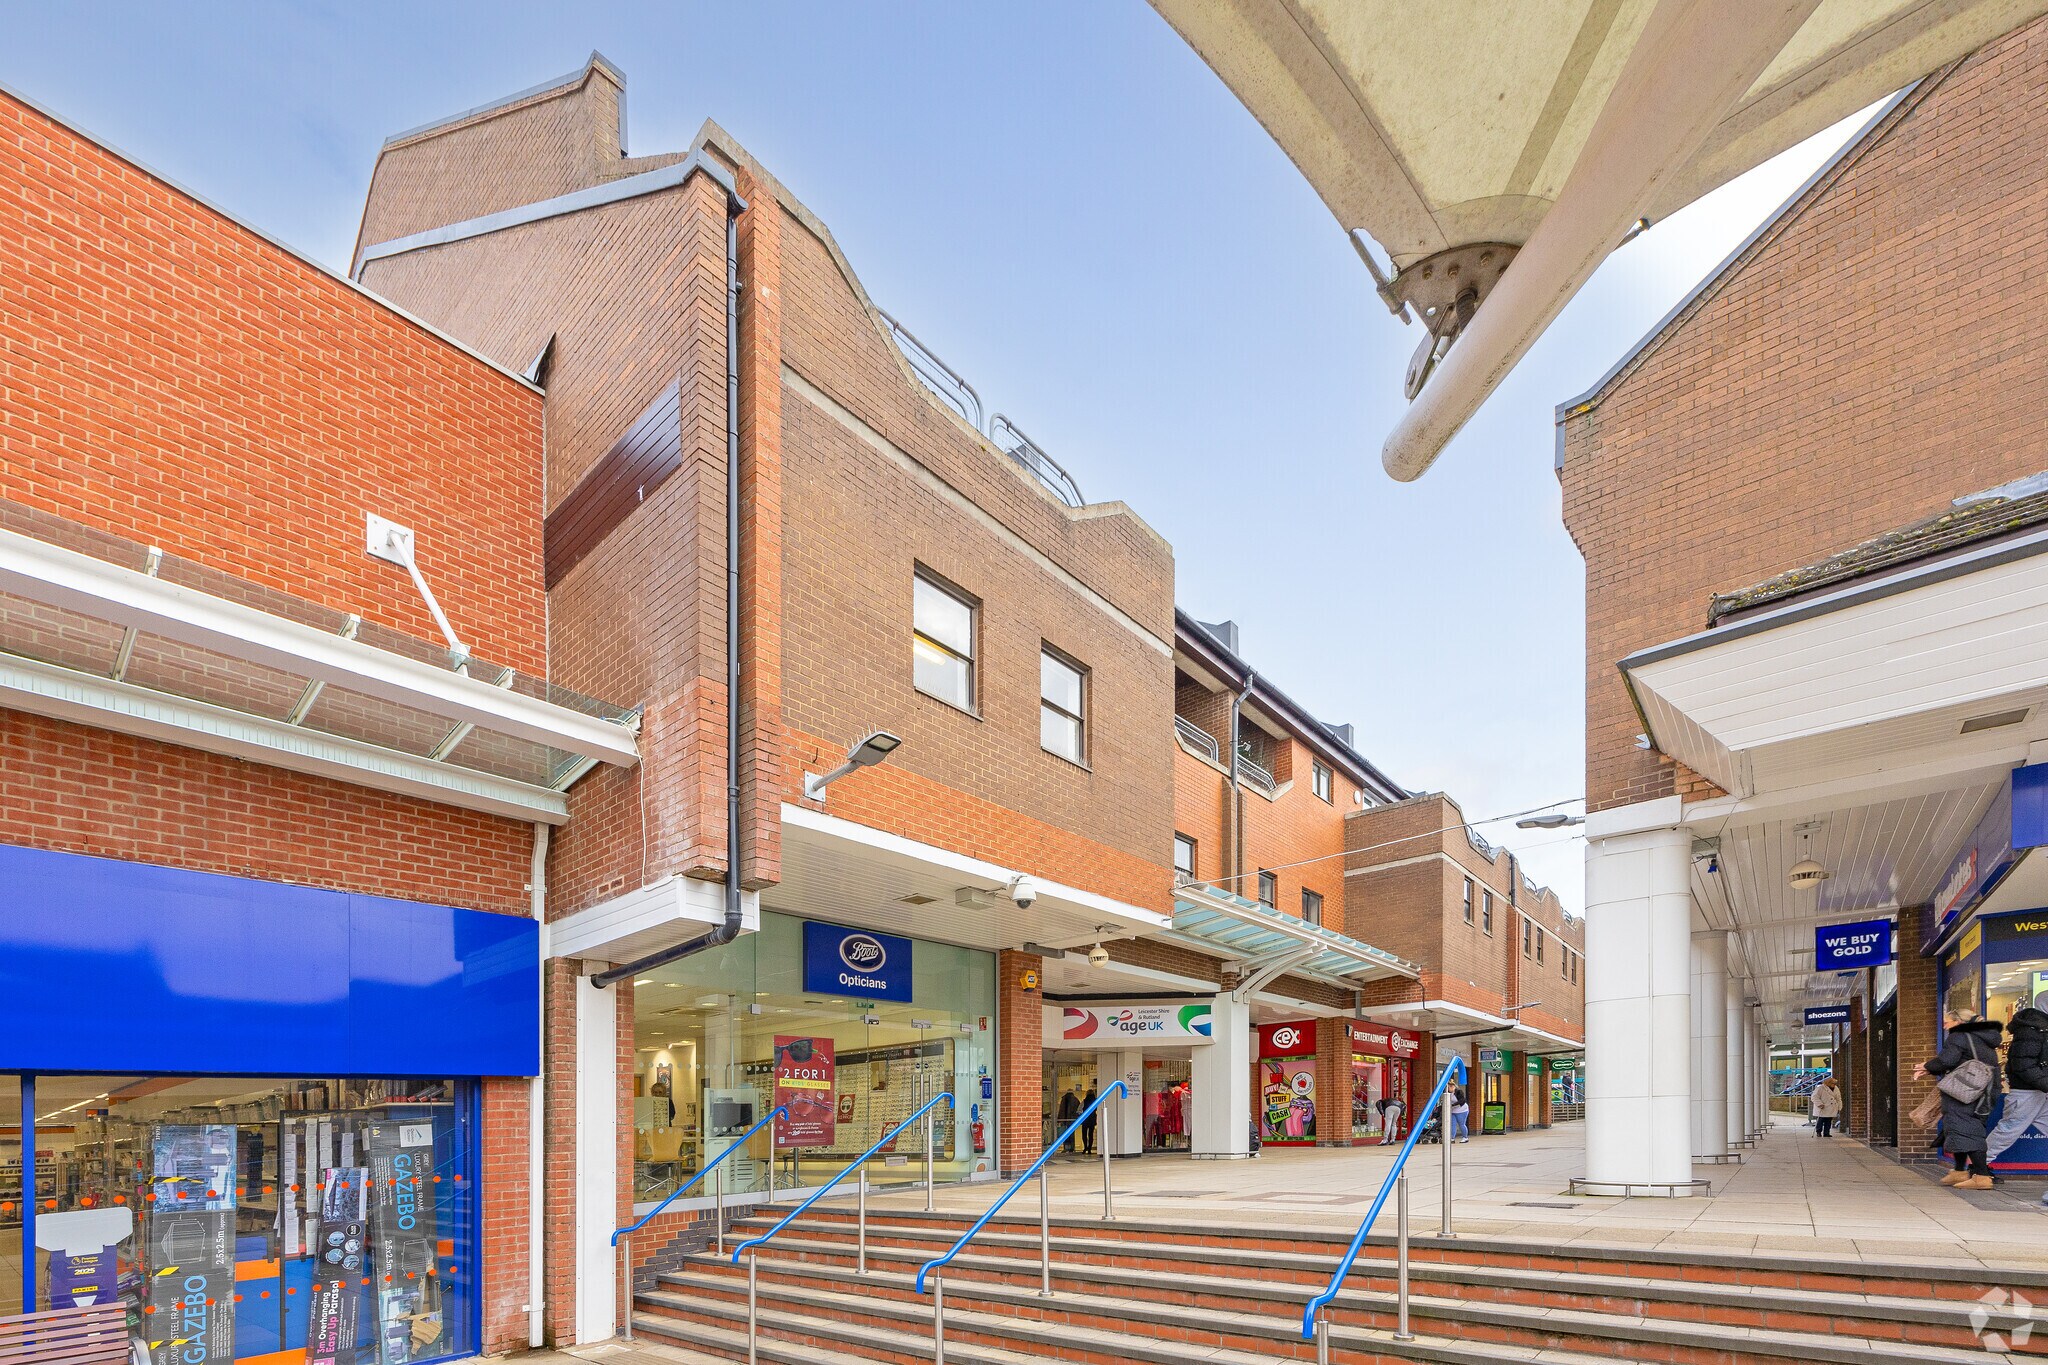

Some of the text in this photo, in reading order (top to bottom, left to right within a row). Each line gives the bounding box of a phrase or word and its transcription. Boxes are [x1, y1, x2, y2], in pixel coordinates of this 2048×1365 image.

[2015, 921, 2048, 932] Wes
[1825, 933, 1880, 947] WE BUY
[849, 941, 879, 962] Boots
[1833, 945, 1872, 957] GOLD
[839, 973, 887, 989] Opticians
[1808, 1011, 1847, 1019] shoezone
[783, 1068, 826, 1079] 2 FOR 1
[1271, 1095, 1287, 1103] STUFF
[1272, 1109, 1288, 1120] CASH
[393, 1153, 416, 1231] GAZEBO
[215, 1230, 225, 1265] 2.5x2.5m
[183, 1275, 207, 1364] GAZEBO
[318, 1292, 331, 1340] Overhanging
[326, 1280, 340, 1353] Easy Up Parasol
[170, 1316, 179, 1339] STEEL
[170, 1341, 179, 1365] LUXUR
[317, 1341, 326, 1354] 3m
